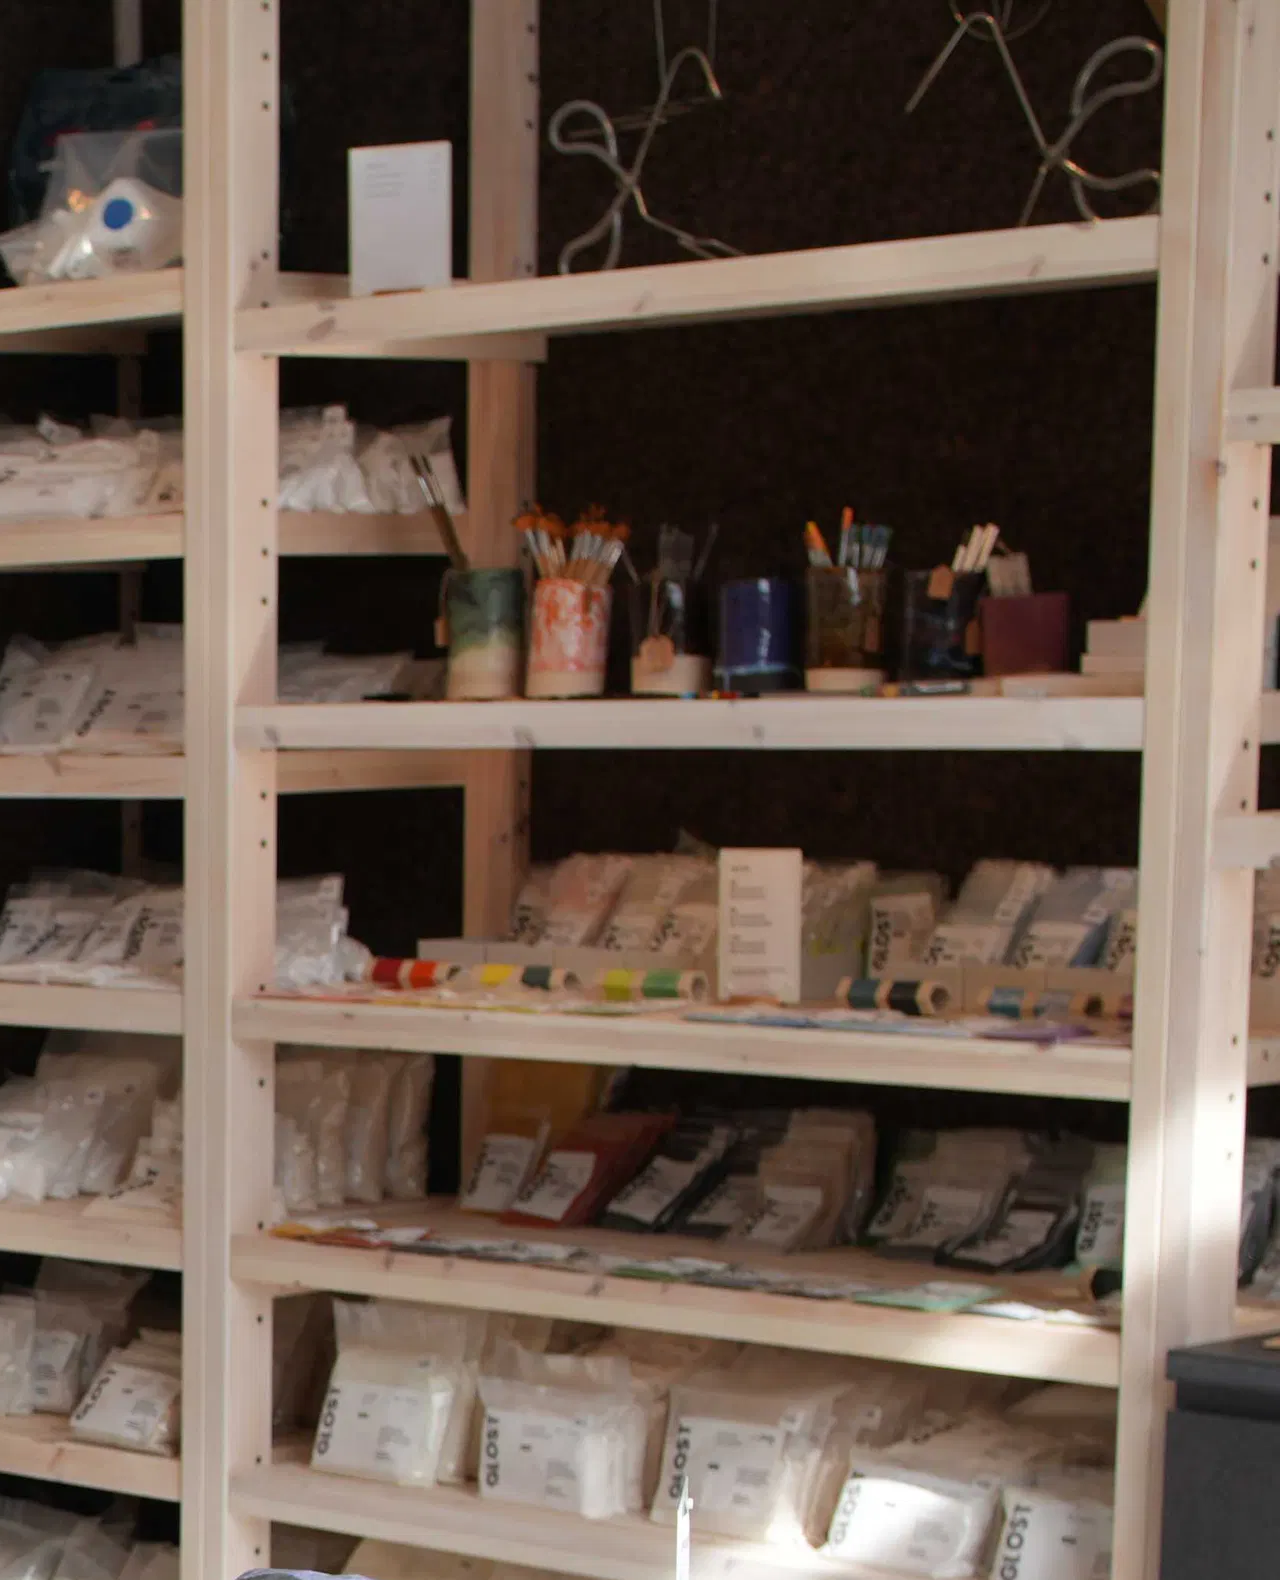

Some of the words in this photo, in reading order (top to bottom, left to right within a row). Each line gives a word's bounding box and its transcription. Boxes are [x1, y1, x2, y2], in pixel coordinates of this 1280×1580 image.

[872, 909, 891, 972] GLOST
[318, 1385, 341, 1455] GLOST
[486, 1415, 500, 1488] GLOST
[835, 1470, 865, 1545] GLOST
